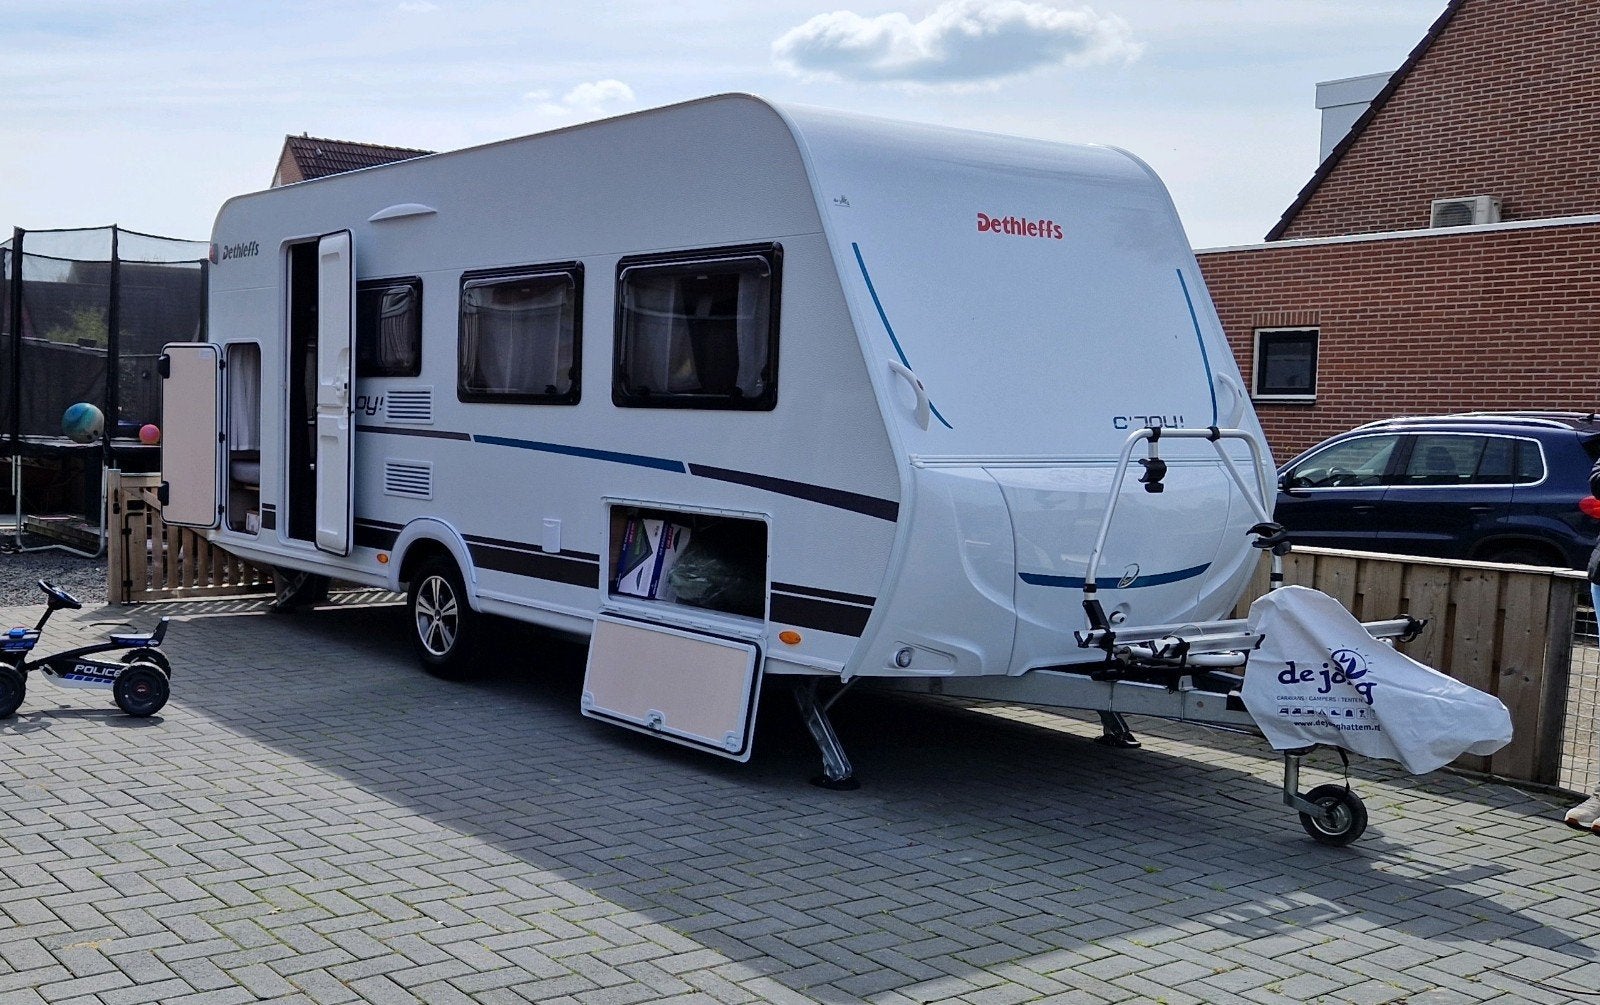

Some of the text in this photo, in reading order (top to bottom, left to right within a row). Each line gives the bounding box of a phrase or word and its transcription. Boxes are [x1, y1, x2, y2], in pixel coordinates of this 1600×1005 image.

[977, 212, 1063, 240] Dethleffs
[222, 240, 260, 260] Dethleffs
[73, 664, 121, 678] POLICE
[1277, 660, 1378, 706] de jog
[1308, 695, 1337, 703] CAMPERS
[1341, 696, 1364, 704] TENTEN
